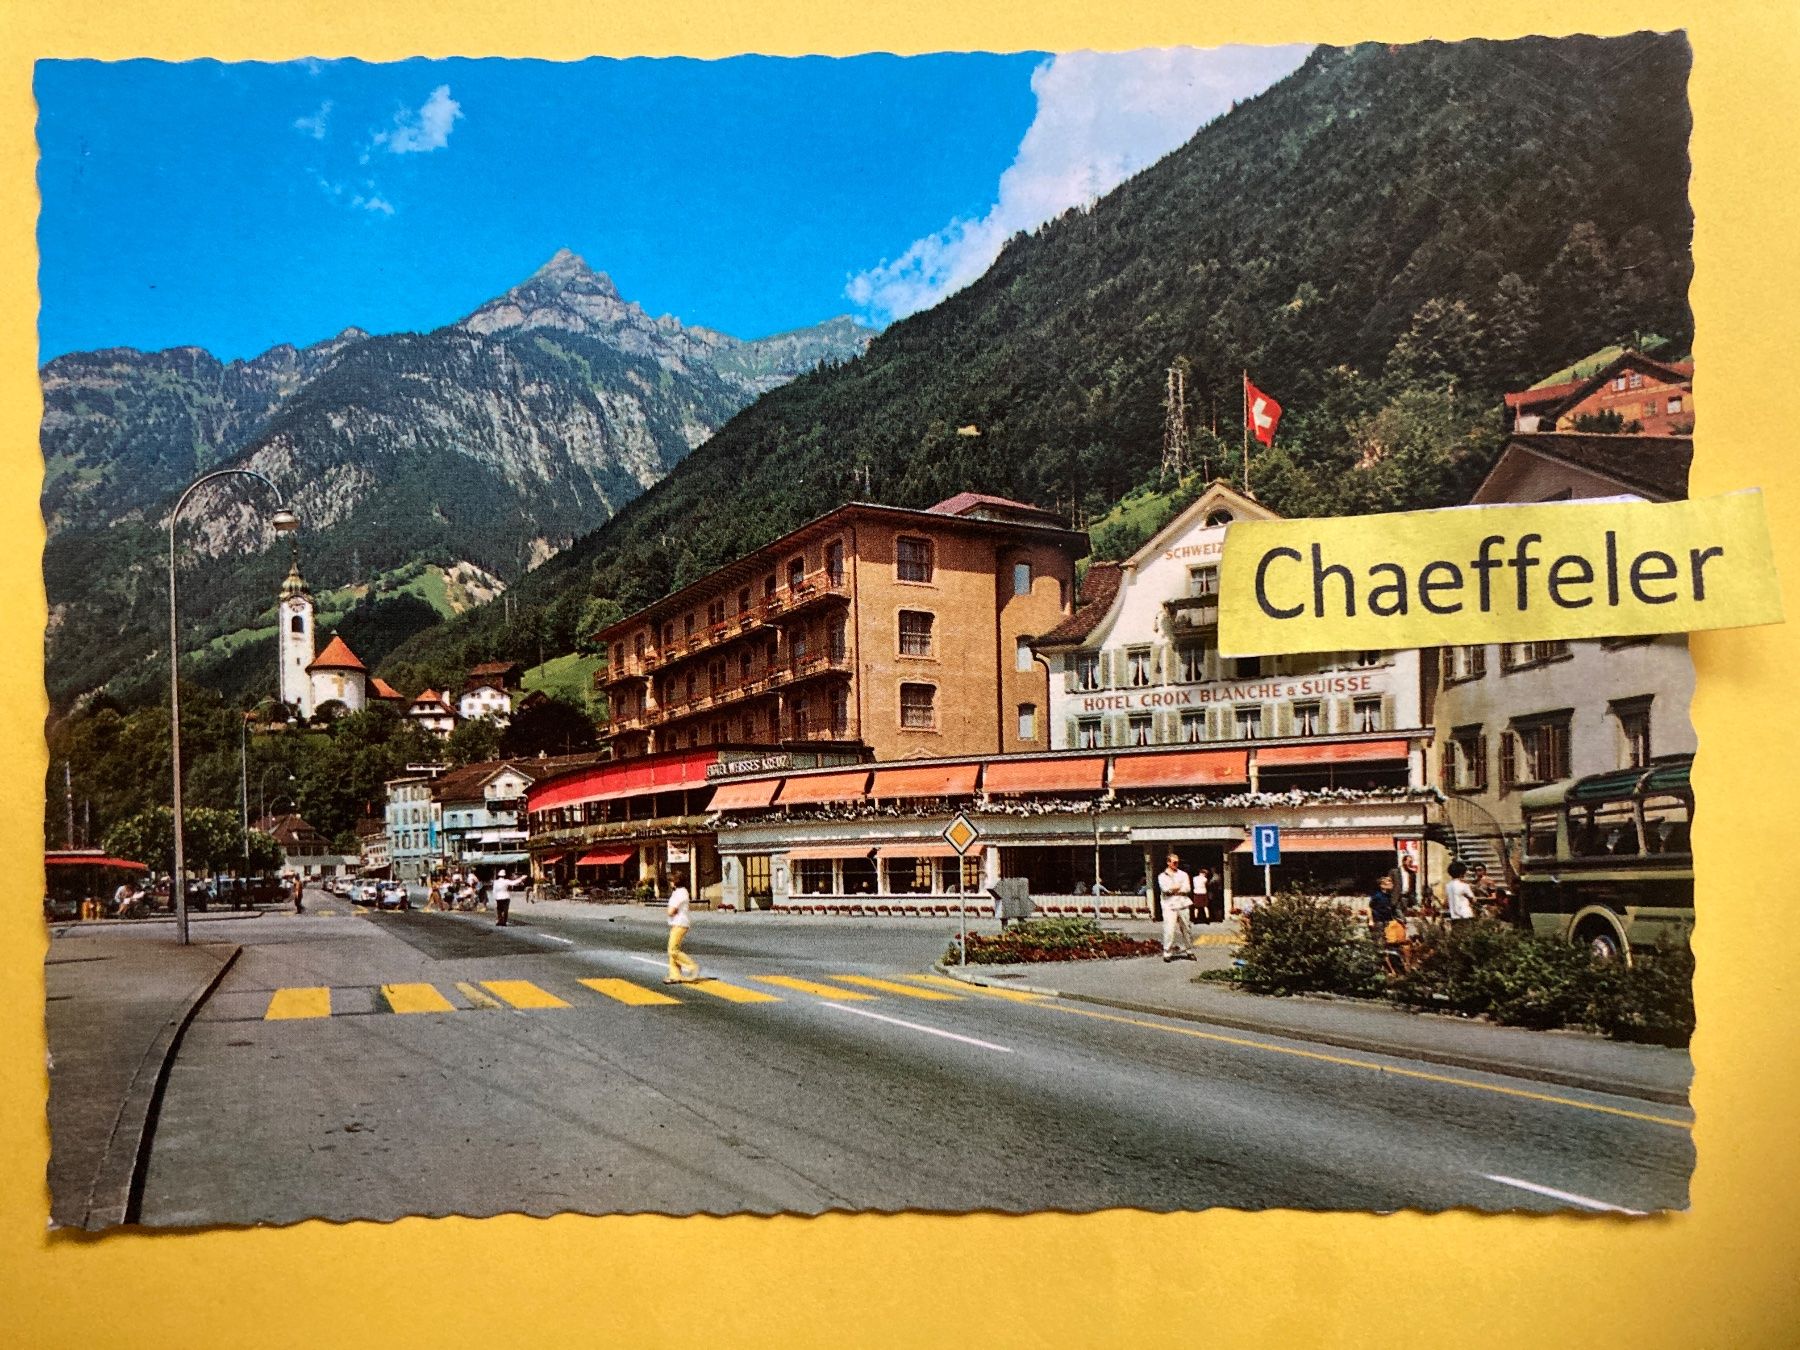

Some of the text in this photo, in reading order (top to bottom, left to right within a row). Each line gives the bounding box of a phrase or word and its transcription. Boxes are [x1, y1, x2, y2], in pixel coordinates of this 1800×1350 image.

[1254, 530, 1723, 620] Chaeffeler
[1084, 695, 1134, 711] HOTEL
[1140, 690, 1192, 707] CROIX
[1200, 683, 1282, 702] BLANCHE
[1301, 676, 1371, 695] SUISSE
[1261, 829, 1275, 862] P
